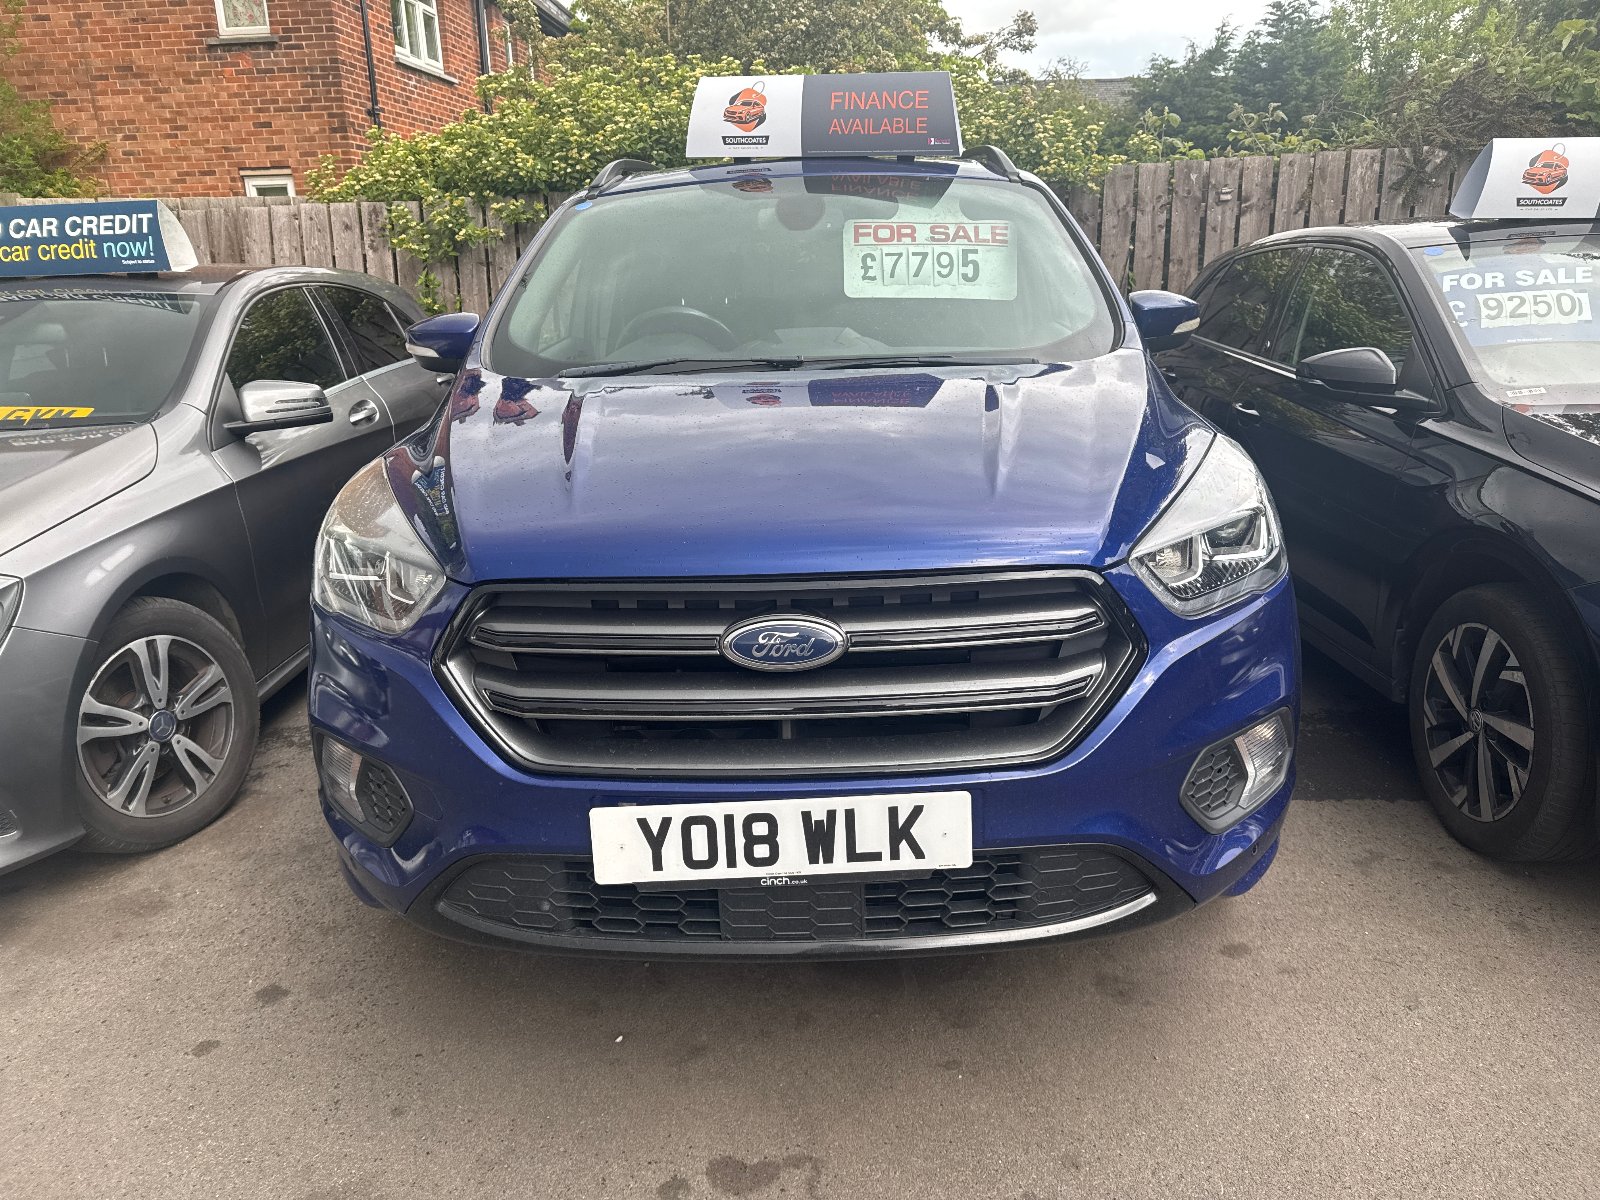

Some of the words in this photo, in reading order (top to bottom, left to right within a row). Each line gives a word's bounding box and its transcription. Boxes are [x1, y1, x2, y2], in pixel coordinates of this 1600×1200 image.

[830, 90, 929, 111] FINANCE
[829, 117, 928, 135] AVAILABLE
[8, 217, 59, 239] CAR
[64, 213, 153, 237] CREDIT
[853, 224, 916, 243] FOR
[929, 224, 1009, 244] SALE
[0, 244, 32, 262] car
[37, 238, 98, 261] credit
[103, 235, 155, 258] now!
[1442, 271, 1505, 293] FOR
[1515, 266, 1594, 287] SALE
[751, 631, 815, 658] Ford
[636, 812, 780, 872] YO18
[800, 804, 926, 865] WLK
[760, 876, 808, 886] cinch.co.uk
